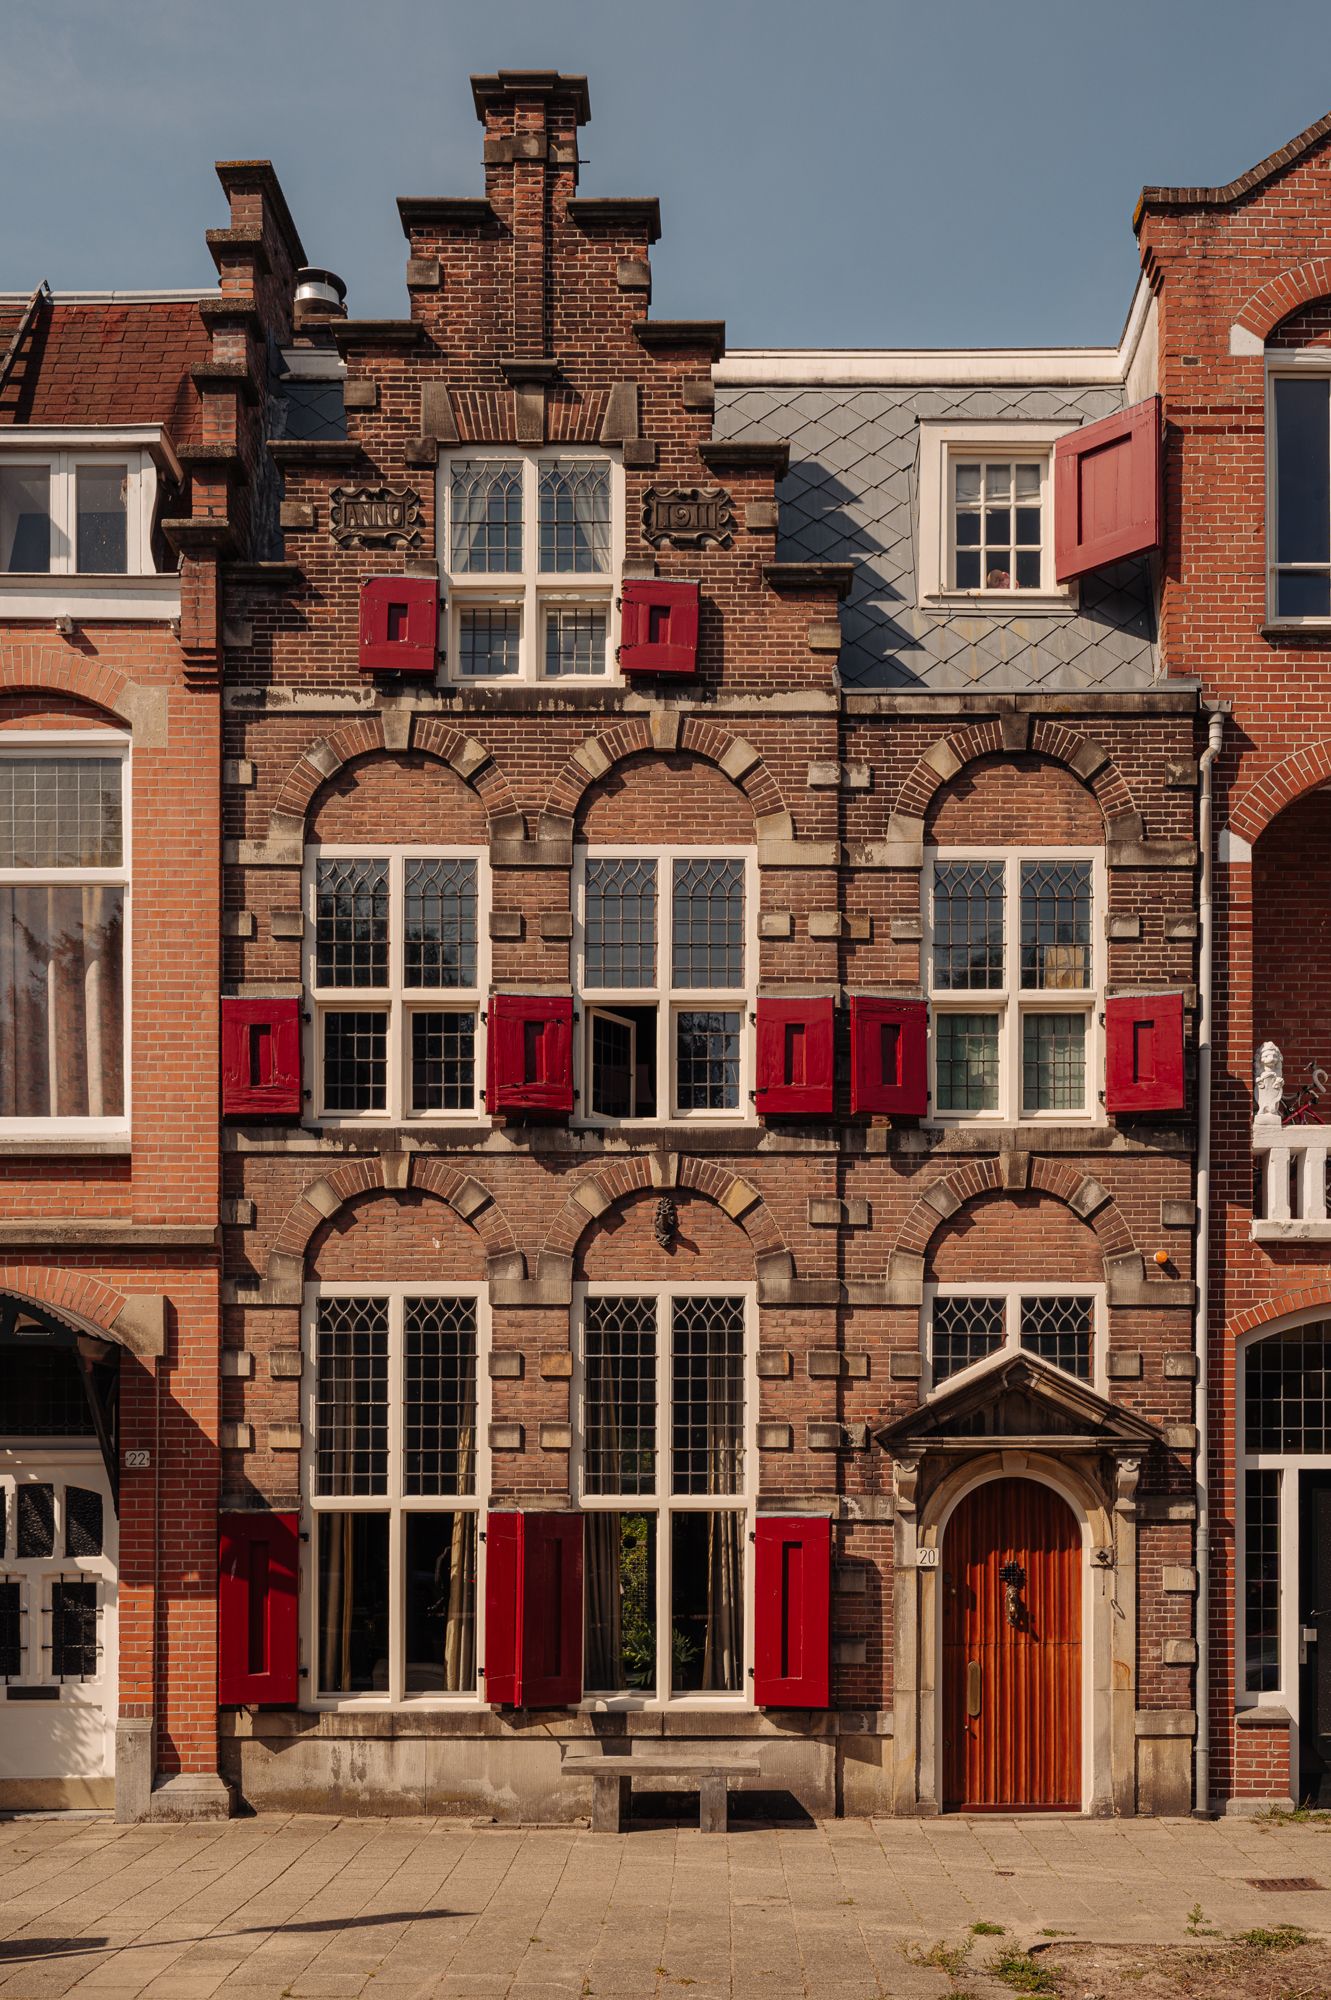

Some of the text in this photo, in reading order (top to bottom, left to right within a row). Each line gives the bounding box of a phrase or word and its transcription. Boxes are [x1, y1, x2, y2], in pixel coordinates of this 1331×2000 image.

[345, 503, 402, 527] ANNO
[661, 504, 710, 528] 1911
[128, 1452, 146, 1466] 22
[919, 1549, 936, 1565] 20
